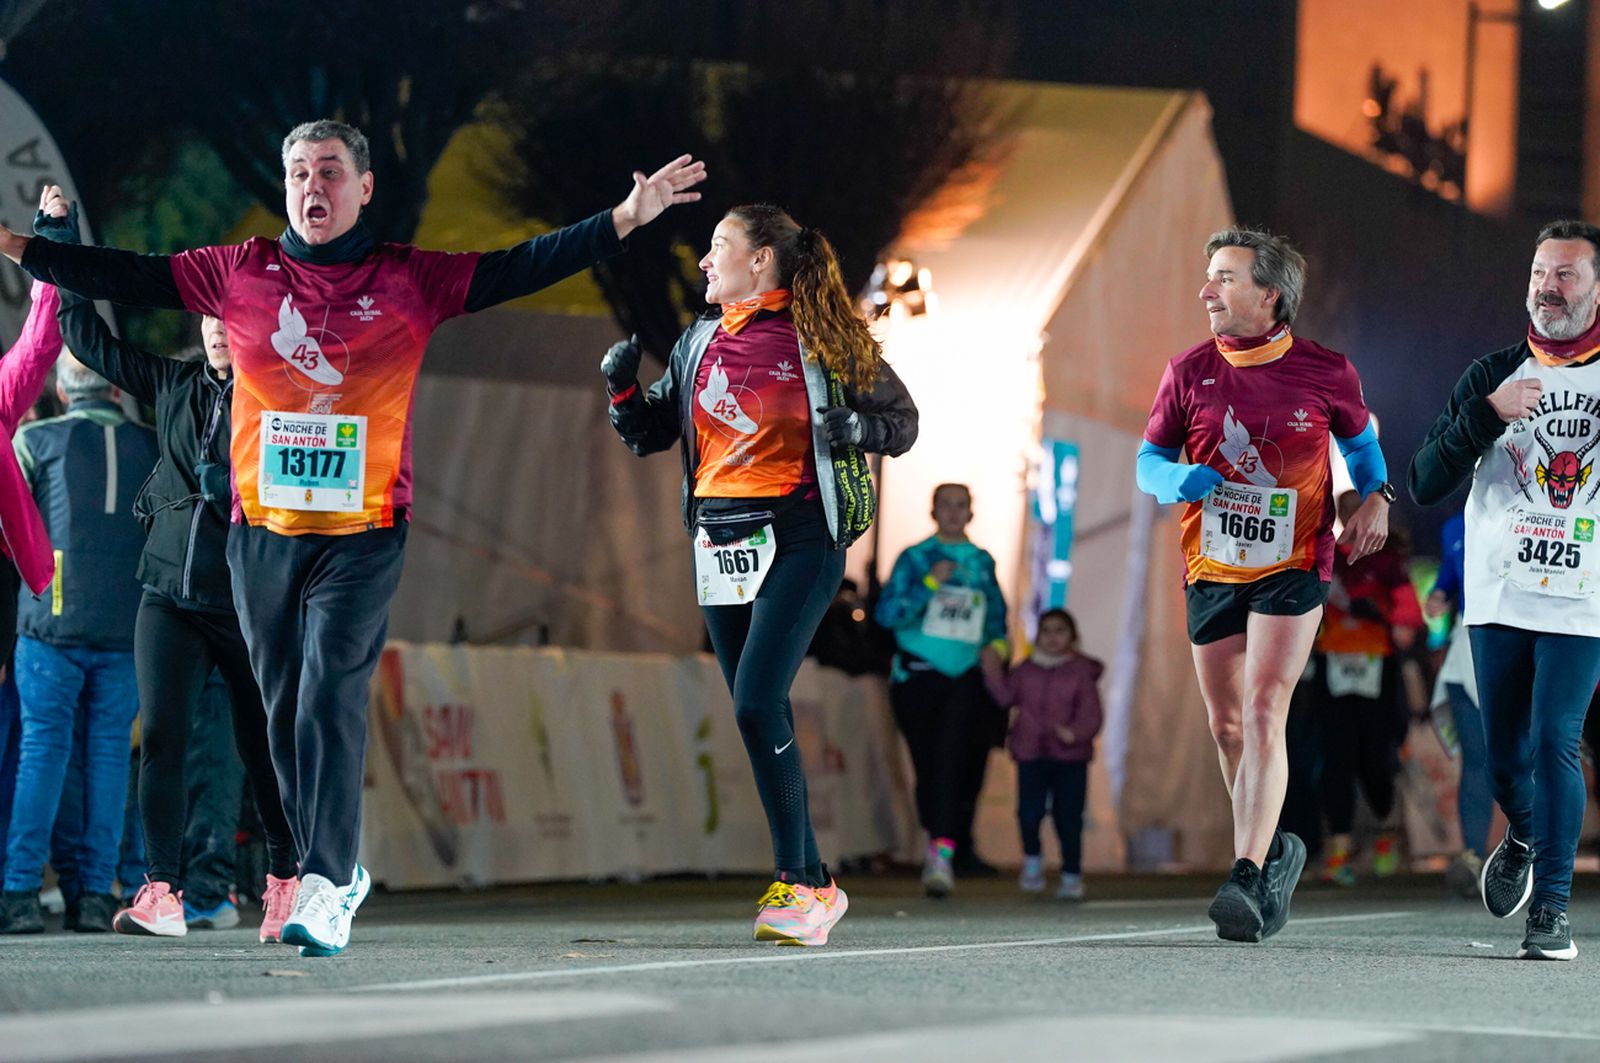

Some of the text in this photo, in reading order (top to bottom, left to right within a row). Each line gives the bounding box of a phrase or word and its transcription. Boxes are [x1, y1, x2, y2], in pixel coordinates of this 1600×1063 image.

[291, 344, 319, 370] 43
[713, 399, 737, 421] 43
[283, 424, 313, 434] NOCHE
[315, 426, 327, 435] DE
[1546, 418, 1591, 438] CLUB
[272, 434, 290, 445] SAN
[278, 448, 346, 478] 13177
[1236, 452, 1258, 474] 43
[1224, 490, 1250, 502] NOCHE
[1251, 494, 1262, 504] DE
[1212, 498, 1229, 510] SAN
[1230, 502, 1262, 515] ANTÓN
[1218, 512, 1276, 543] 1666
[1554, 518, 1566, 528] DE
[1532, 527, 1565, 540] ANTÓN
[702, 540, 716, 549] SA
[1235, 540, 1252, 548] Javier
[1518, 537, 1581, 569] 3425
[714, 548, 759, 575] 1667
